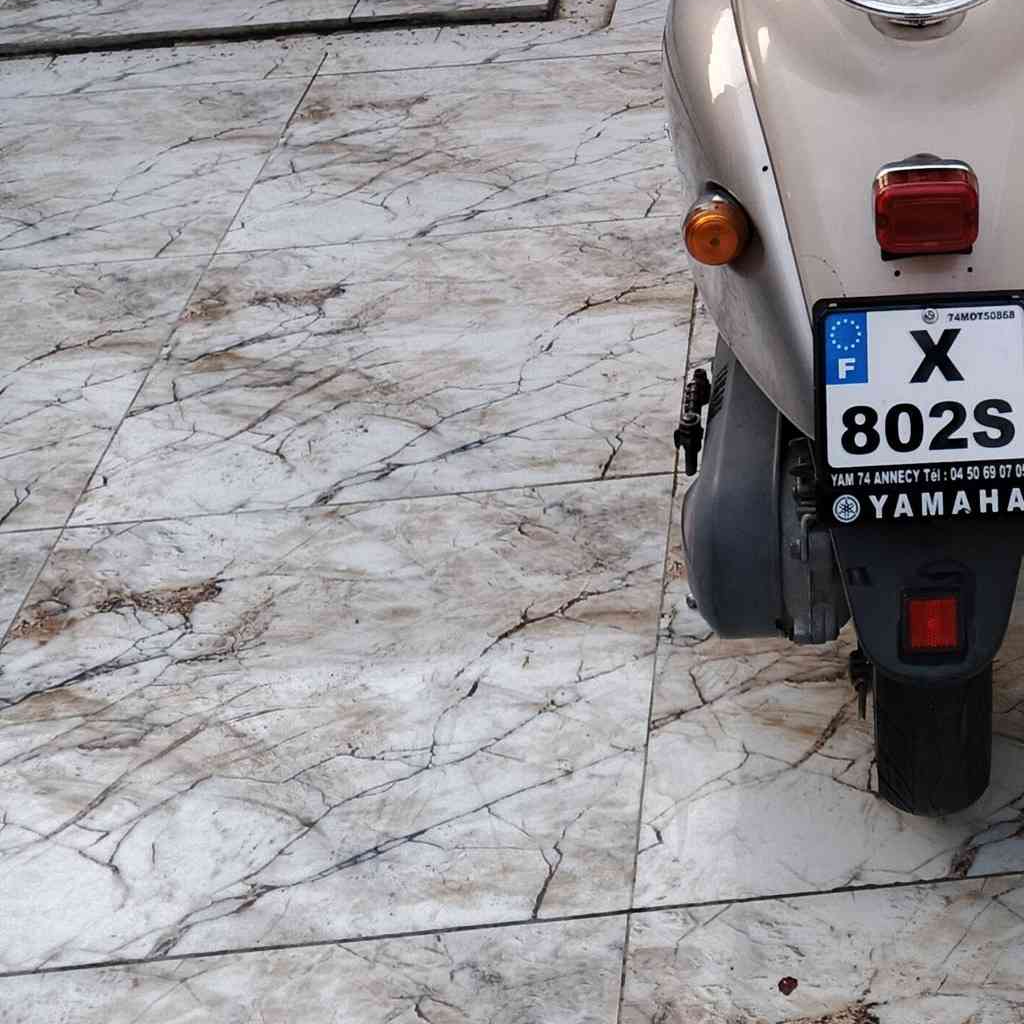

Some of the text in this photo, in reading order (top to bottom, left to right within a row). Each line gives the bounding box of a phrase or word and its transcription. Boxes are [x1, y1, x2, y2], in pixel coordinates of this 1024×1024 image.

[838, 357, 856, 379] F
[909, 328, 965, 383] X
[841, 398, 1016, 455] 802S
[831, 473, 855, 487] YAM
[857, 471, 871, 485] 74
[874, 469, 920, 484] ANNECY
[923, 468, 941, 482] Tél
[950, 467, 963, 481] 04
[967, 466, 980, 480] 50
[983, 465, 996, 479] 69
[999, 464, 1012, 478] 07
